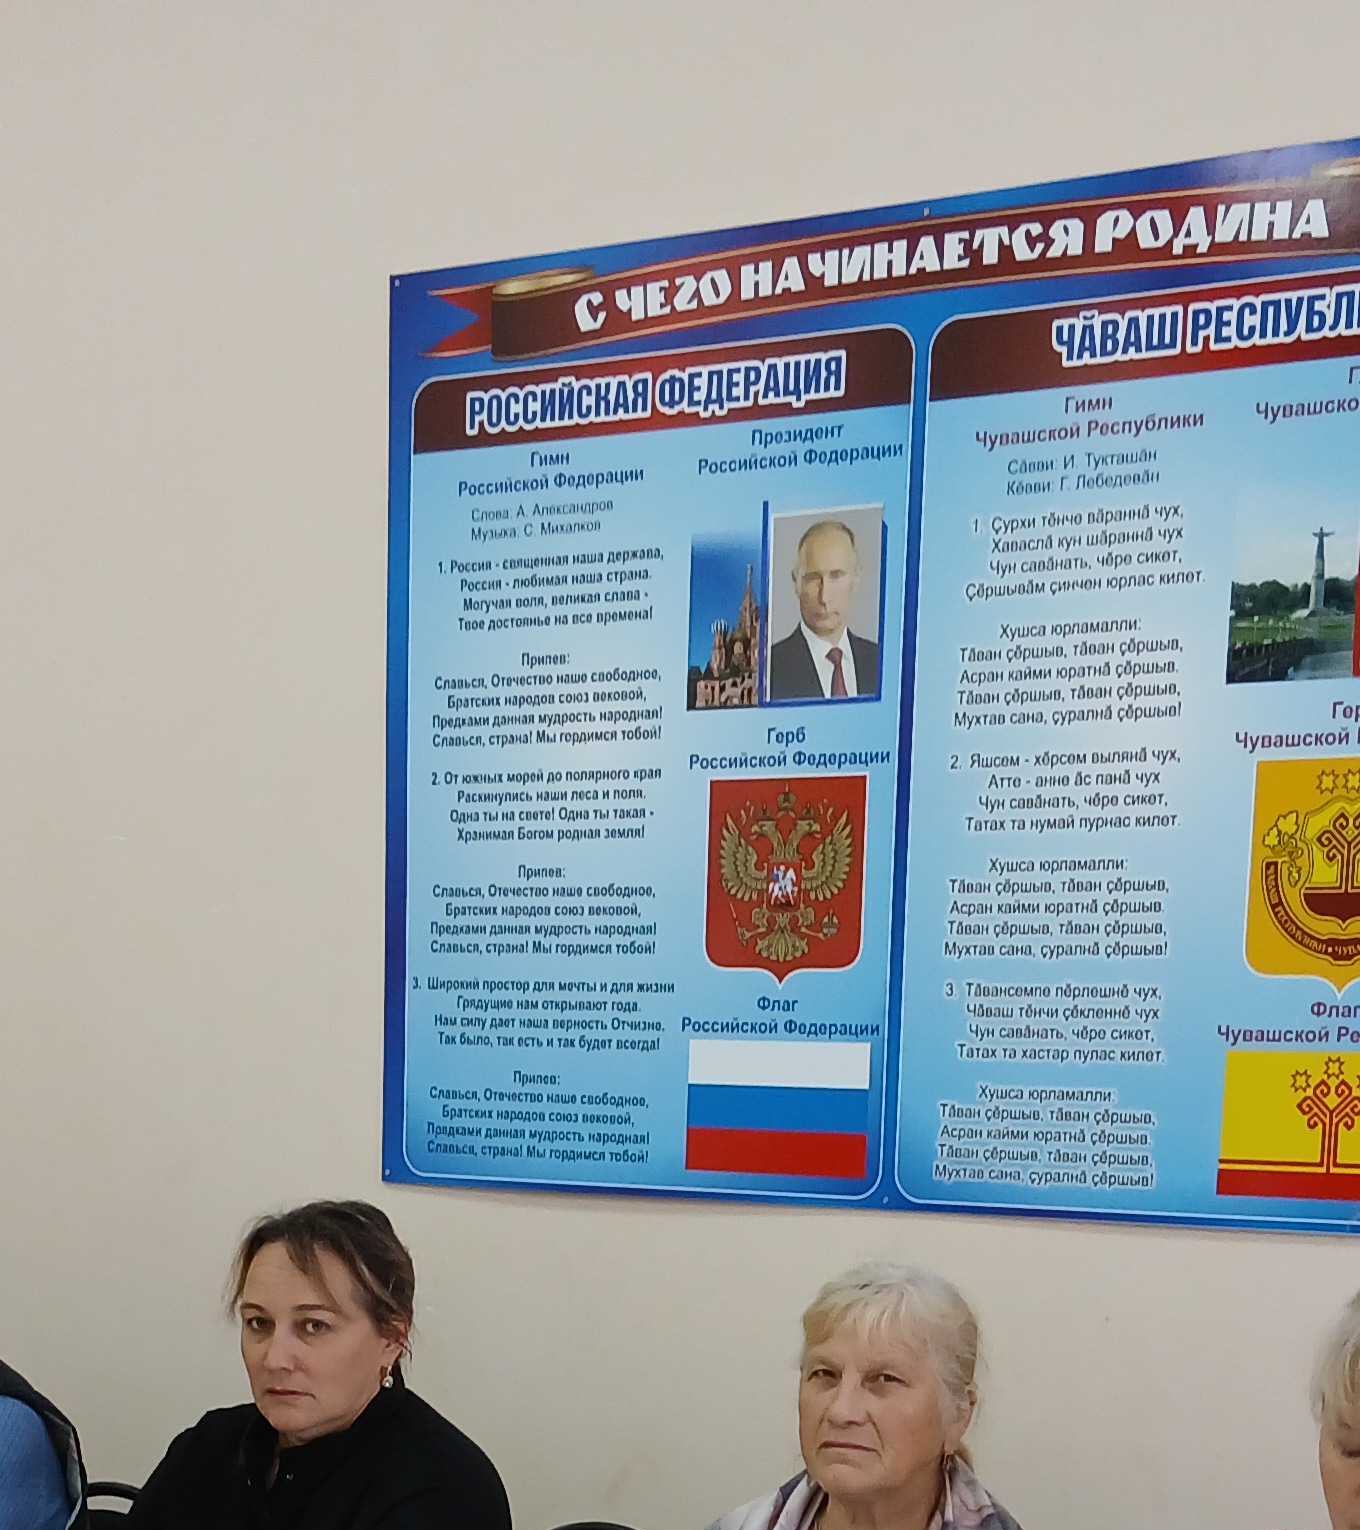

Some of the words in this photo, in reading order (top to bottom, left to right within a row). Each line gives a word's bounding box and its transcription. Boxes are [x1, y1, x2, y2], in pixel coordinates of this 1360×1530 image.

[574, 290, 607, 333] С
[614, 266, 733, 321] ЧЕГО
[739, 218, 1085, 302] НАЧИНАЕТСЯ
[1094, 197, 1330, 255] РОДИНА
[467, 374, 650, 435] РОССИЙСКАЯ
[657, 352, 846, 416] ФЕДЕРАЦИЯ
[1064, 395, 1113, 415] Гимн
[751, 423, 844, 450] Президент
[975, 424, 1081, 453] Чувашской
[1086, 412, 1204, 438] Республики
[530, 450, 570, 468] Гимн
[697, 450, 798, 476] Российской
[802, 442, 903, 467] Федерации
[458, 473, 549, 497] Российской
[553, 468, 644, 490] Федерации
[531, 499, 614, 517] Александров
[540, 520, 601, 536] Михалков
[449, 558, 492, 574] Россия
[502, 554, 569, 570] священная
[572, 551, 604, 565] наша
[460, 577, 502, 593] Россия
[512, 572, 568, 590] любимая
[571, 571, 603, 586] наша
[462, 596, 512, 614] Могучая
[550, 591, 601, 606] великая
[603, 588, 641, 603] слава
[457, 616, 485, 631] Твое
[487, 614, 551, 632] достоянье
[553, 613, 569, 626] на
[571, 612, 593, 625] все
[596, 604, 653, 626] времена!
[490, 672, 553, 688] Отечество
[556, 672, 588, 684] наше
[447, 694, 501, 712] Братских
[504, 693, 555, 709] народов
[558, 691, 589, 705] союз
[432, 713, 490, 731] Предками
[491, 713, 535, 729] данная
[537, 711, 596, 728] мудрость
[599, 704, 663, 725] народная!
[488, 729, 533, 749] страна!
[535, 728, 557, 744] Мы
[559, 729, 618, 747] гордимся
[620, 724, 662, 741] тобой!
[766, 725, 806, 748] Герб
[1234, 726, 1350, 755] Чувашской
[689, 749, 787, 770] Российской
[792, 749, 891, 770] Федерации
[443, 770, 459, 785] От
[461, 772, 504, 785] южных
[506, 768, 544, 786] морей
[546, 770, 563, 785] до
[565, 768, 630, 784] полярного
[633, 767, 662, 783] края
[457, 789, 533, 806] Раскинулись
[535, 789, 568, 802] наши
[570, 788, 599, 802] леса
[601, 788, 610, 800] и
[449, 808, 480, 825] Одна
[482, 810, 499, 822] ты
[501, 810, 515, 822] на
[518, 805, 555, 821] свете!
[558, 806, 590, 823] Одна
[592, 808, 610, 820] ты
[612, 807, 646, 820] такая
[456, 826, 515, 845] Хранимая
[517, 825, 554, 841] Богом
[557, 827, 601, 843] родная
[603, 823, 645, 839] земля!
[427, 975, 480, 994] Широкий
[482, 979, 530, 995] простор
[531, 980, 555, 994] для
[558, 980, 597, 993] мечты
[599, 981, 608, 993] и
[609, 981, 634, 995] для
[636, 981, 675, 994] жизни
[456, 994, 513, 1013] Грядущие
[516, 998, 539, 1011] нам
[541, 999, 608, 1014] открывают
[756, 995, 799, 1012] Флаг
[434, 1012, 458, 1027] Нам
[459, 1016, 488, 1031] силу
[488, 1016, 516, 1031] дает
[518, 1017, 549, 1029] наша
[551, 1018, 608, 1033] верность
[681, 1015, 778, 1035] Российской
[783, 1018, 885, 1044] Федерации
[437, 1030, 457, 1045] Так
[495, 1035, 515, 1047] так
[517, 1035, 544, 1048] есть
[546, 1036, 554, 1048] и
[556, 1036, 576, 1048] так
[578, 1033, 613, 1053] будет
[615, 1036, 660, 1053] всегда!
[1217, 1024, 1330, 1047] Чувашской
